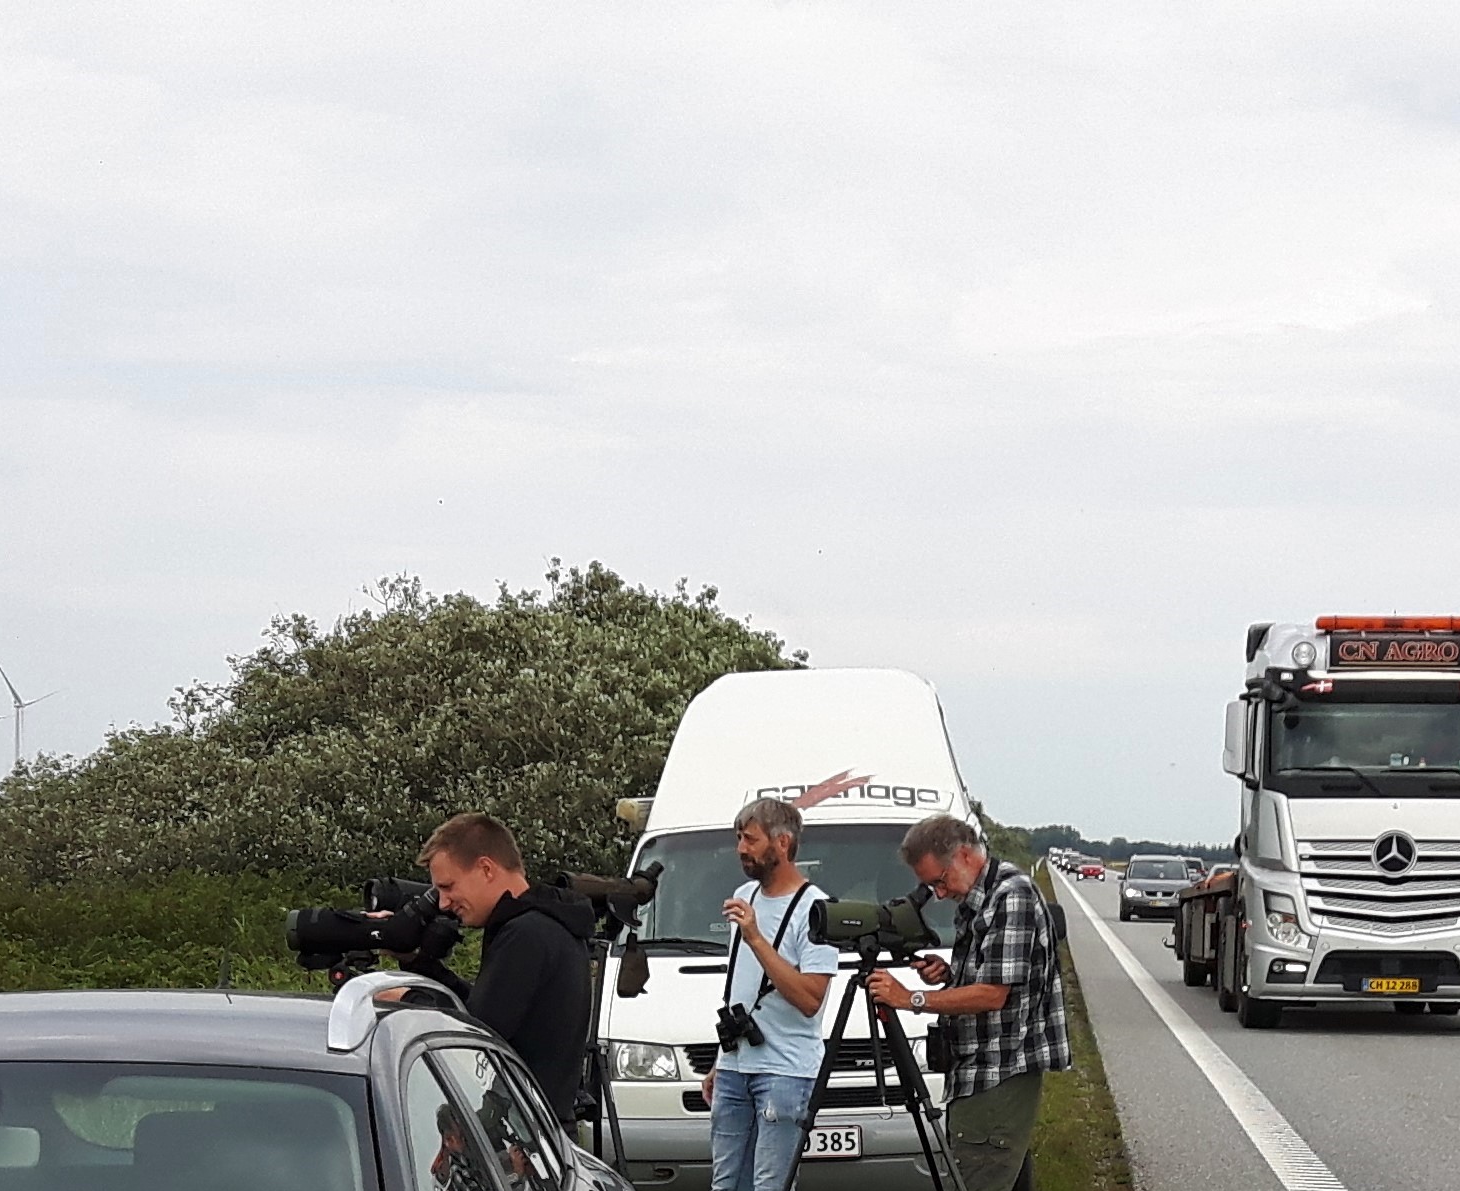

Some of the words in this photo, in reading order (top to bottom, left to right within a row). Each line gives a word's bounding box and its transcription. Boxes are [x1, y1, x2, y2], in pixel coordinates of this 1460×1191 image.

[1338, 641, 1379, 661] CN
[1383, 641, 1459, 662] AGRO
[756, 784, 941, 808] cahago
[816, 1131, 856, 1152] 385
